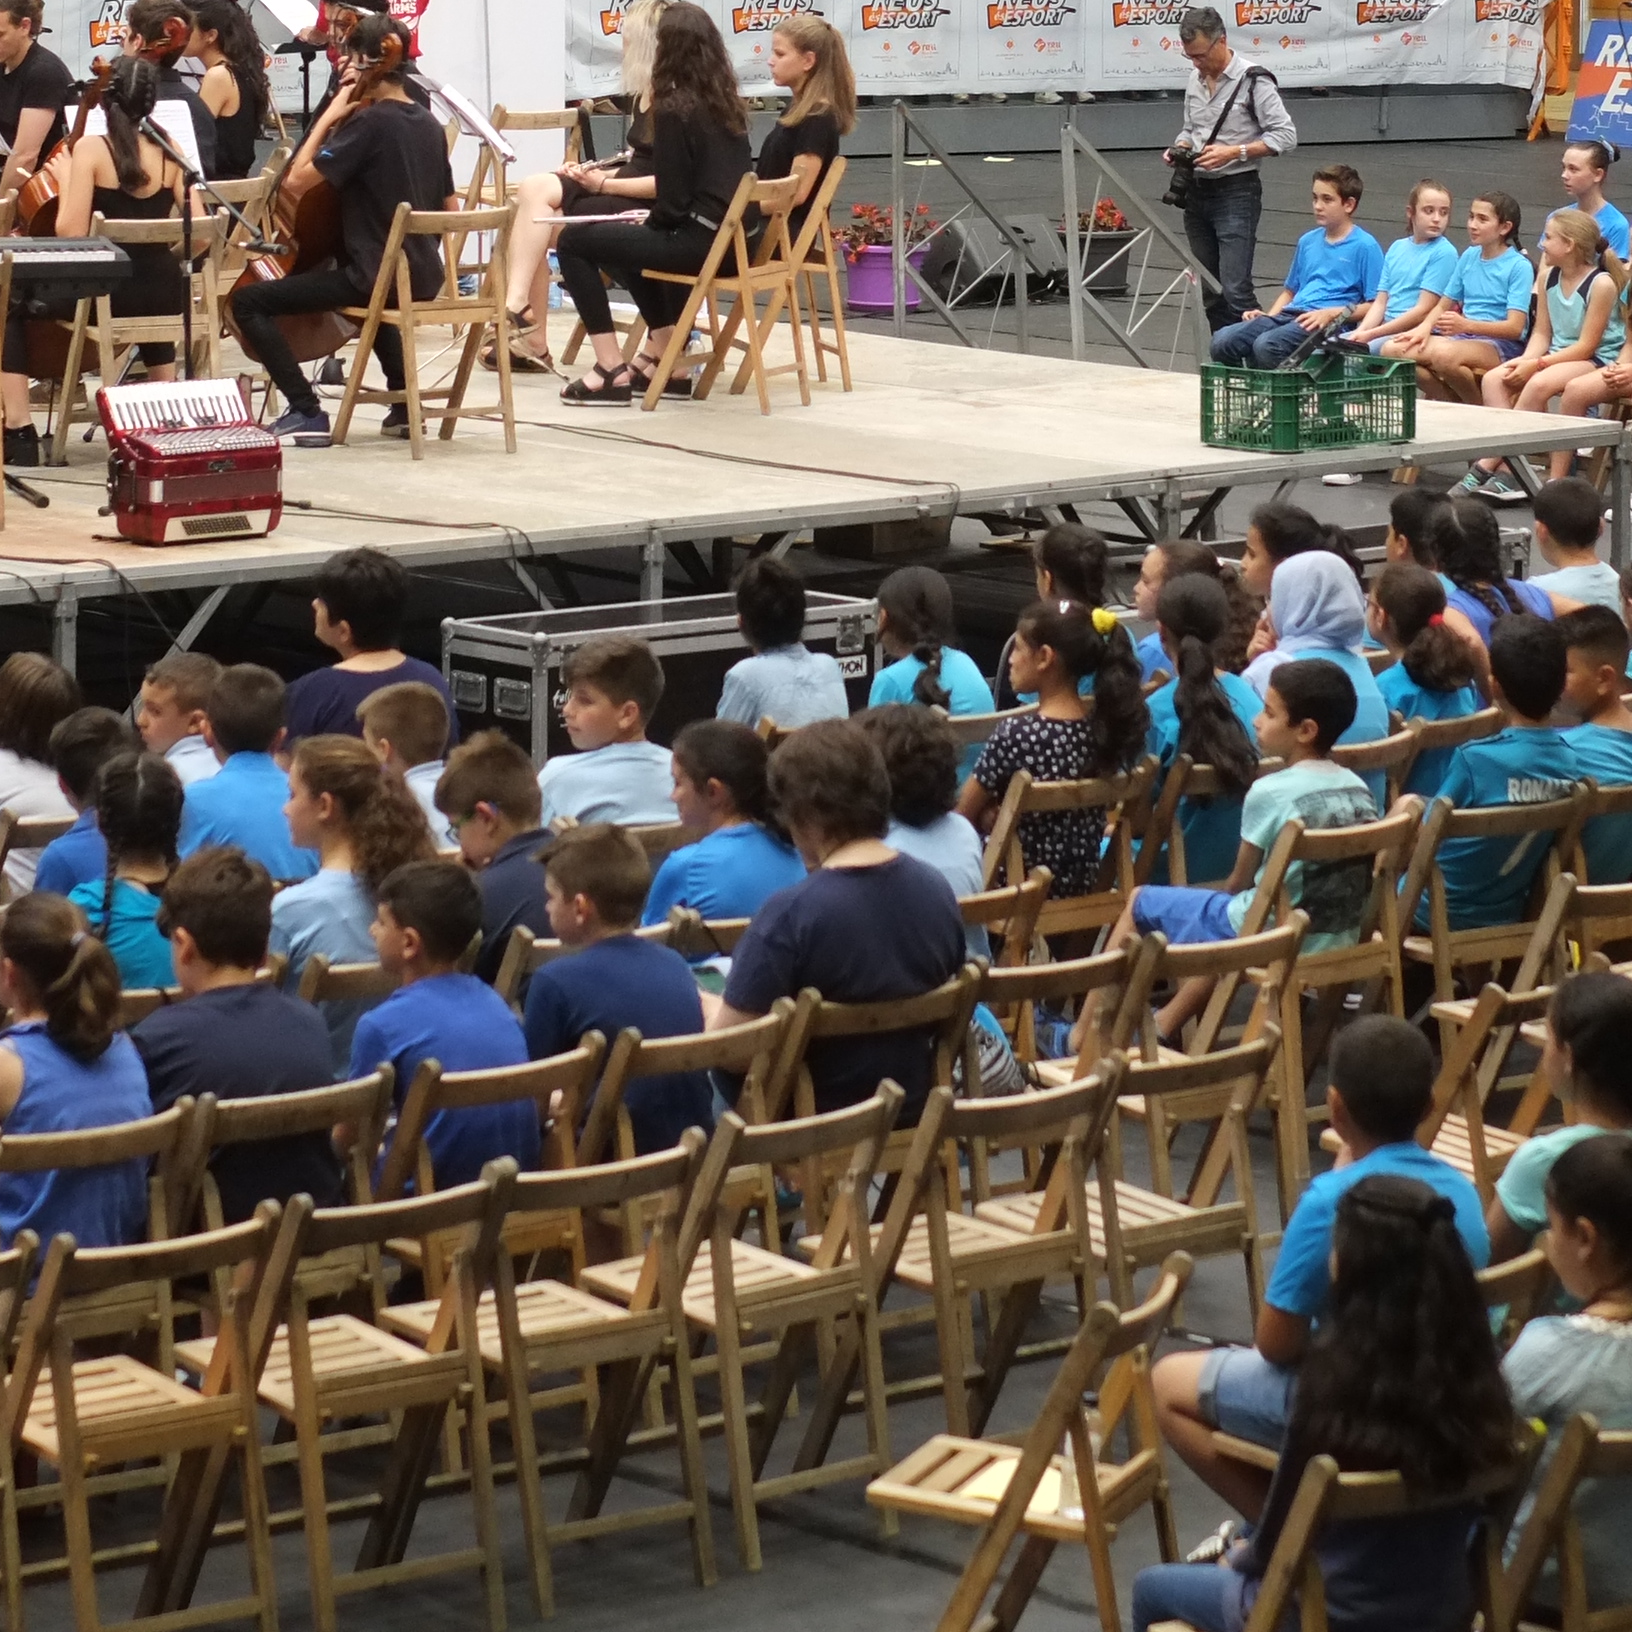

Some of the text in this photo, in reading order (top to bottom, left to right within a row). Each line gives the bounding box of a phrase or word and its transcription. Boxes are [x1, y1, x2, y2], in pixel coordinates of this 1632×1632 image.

[880, 10, 940, 28] ESPORT
[1004, 8, 1066, 27] ESPORT
[1252, 7, 1310, 24] ESPORT
